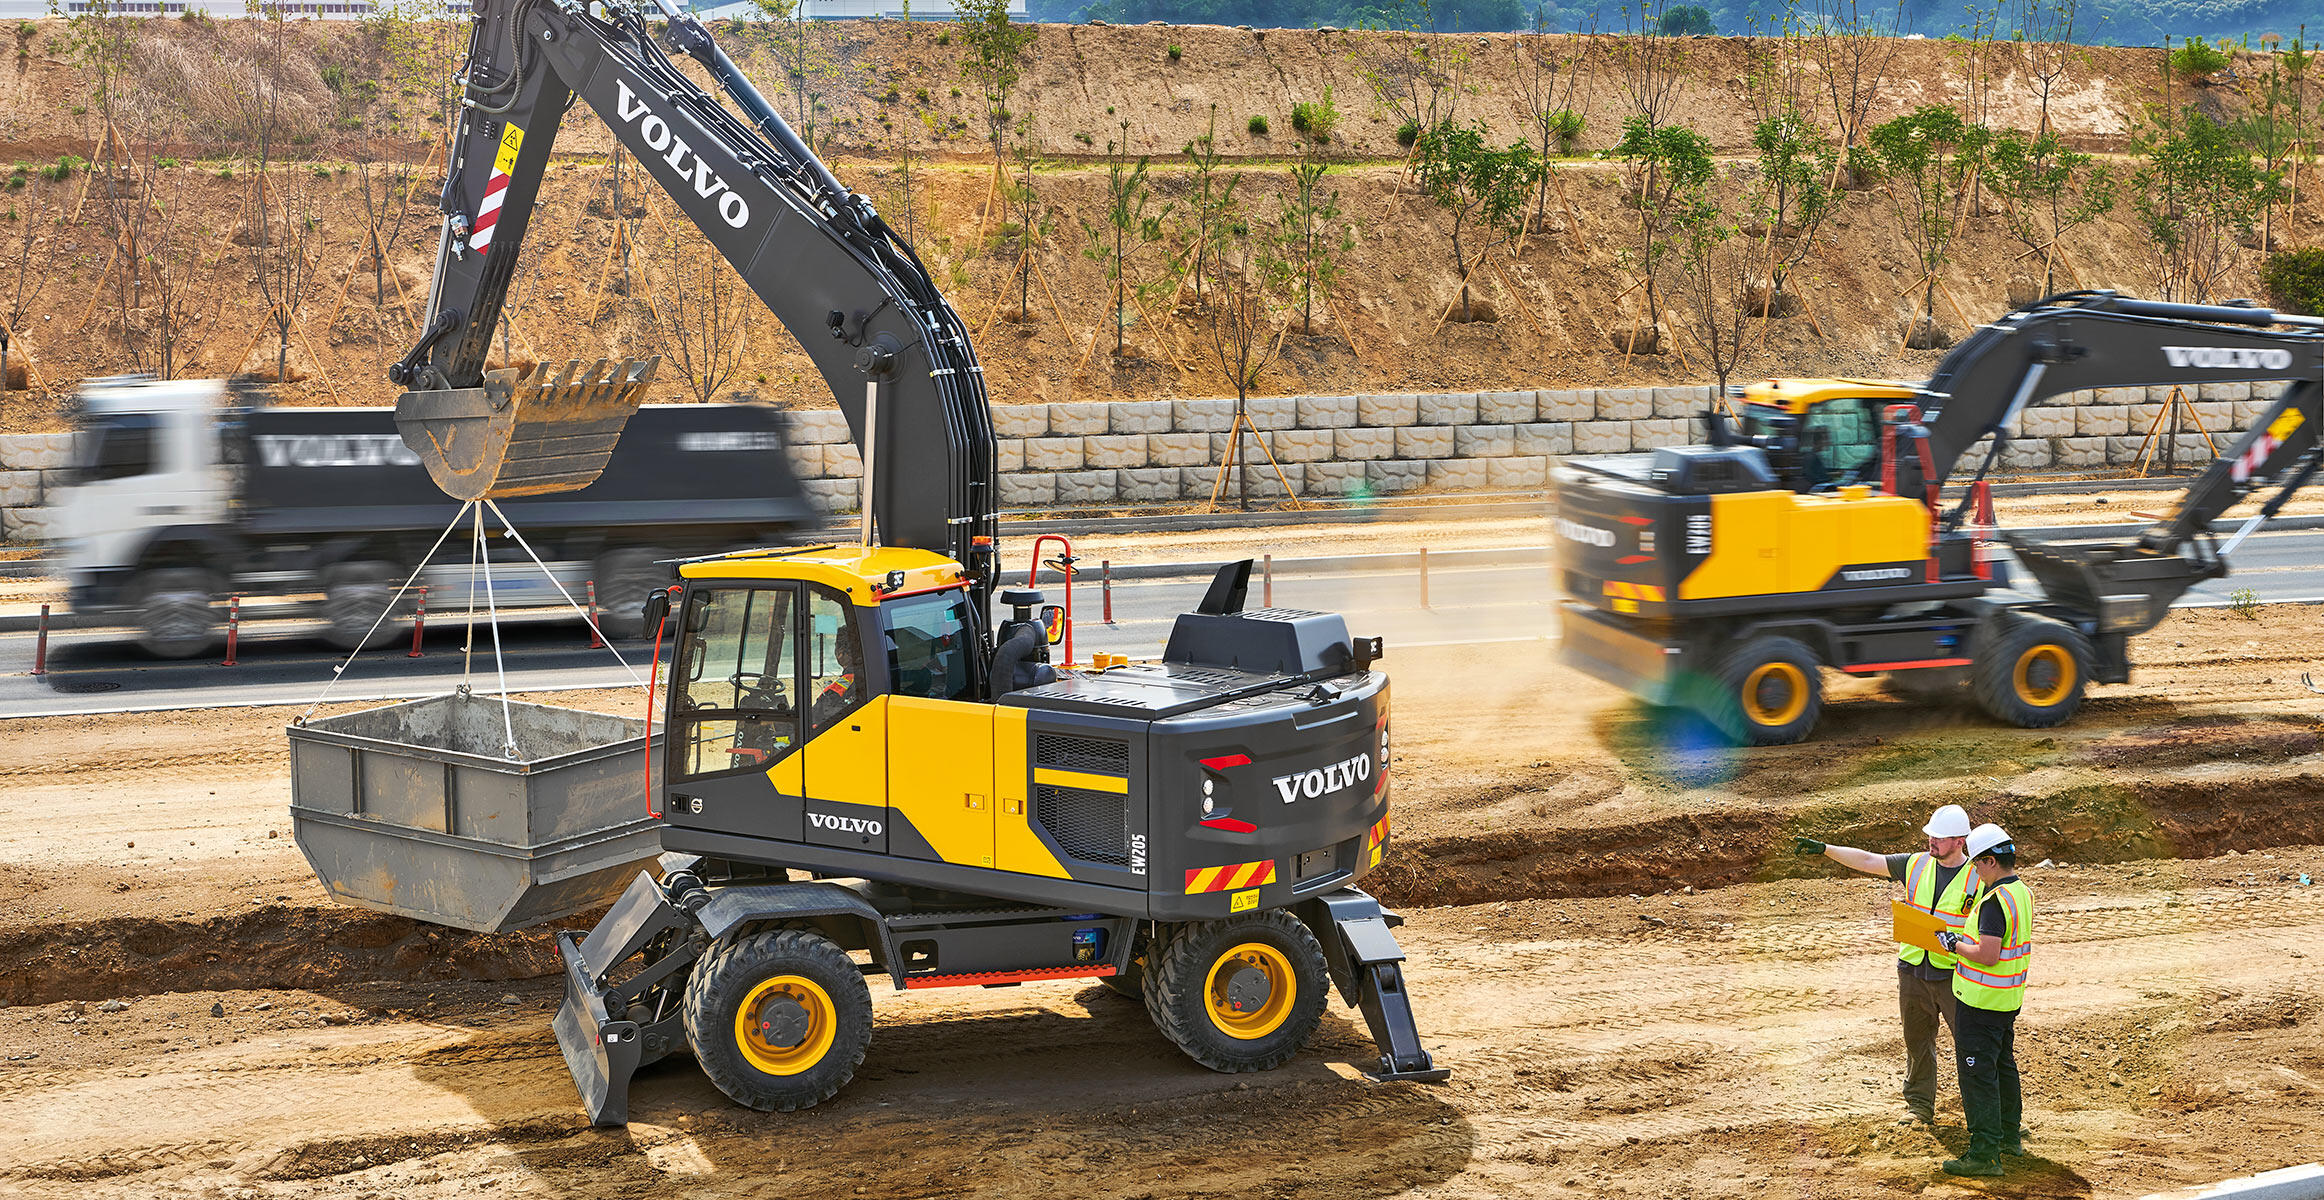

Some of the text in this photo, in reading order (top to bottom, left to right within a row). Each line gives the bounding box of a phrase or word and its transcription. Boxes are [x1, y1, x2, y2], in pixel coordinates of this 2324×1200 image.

[616, 78, 750, 229] VOLVO
[2160, 346, 2293, 370] VOLVO
[733, 731, 744, 768] VOVO
[1272, 752, 1370, 804] VOLVO
[807, 813, 882, 835] VOLVO
[1131, 834, 1146, 875] EW205
